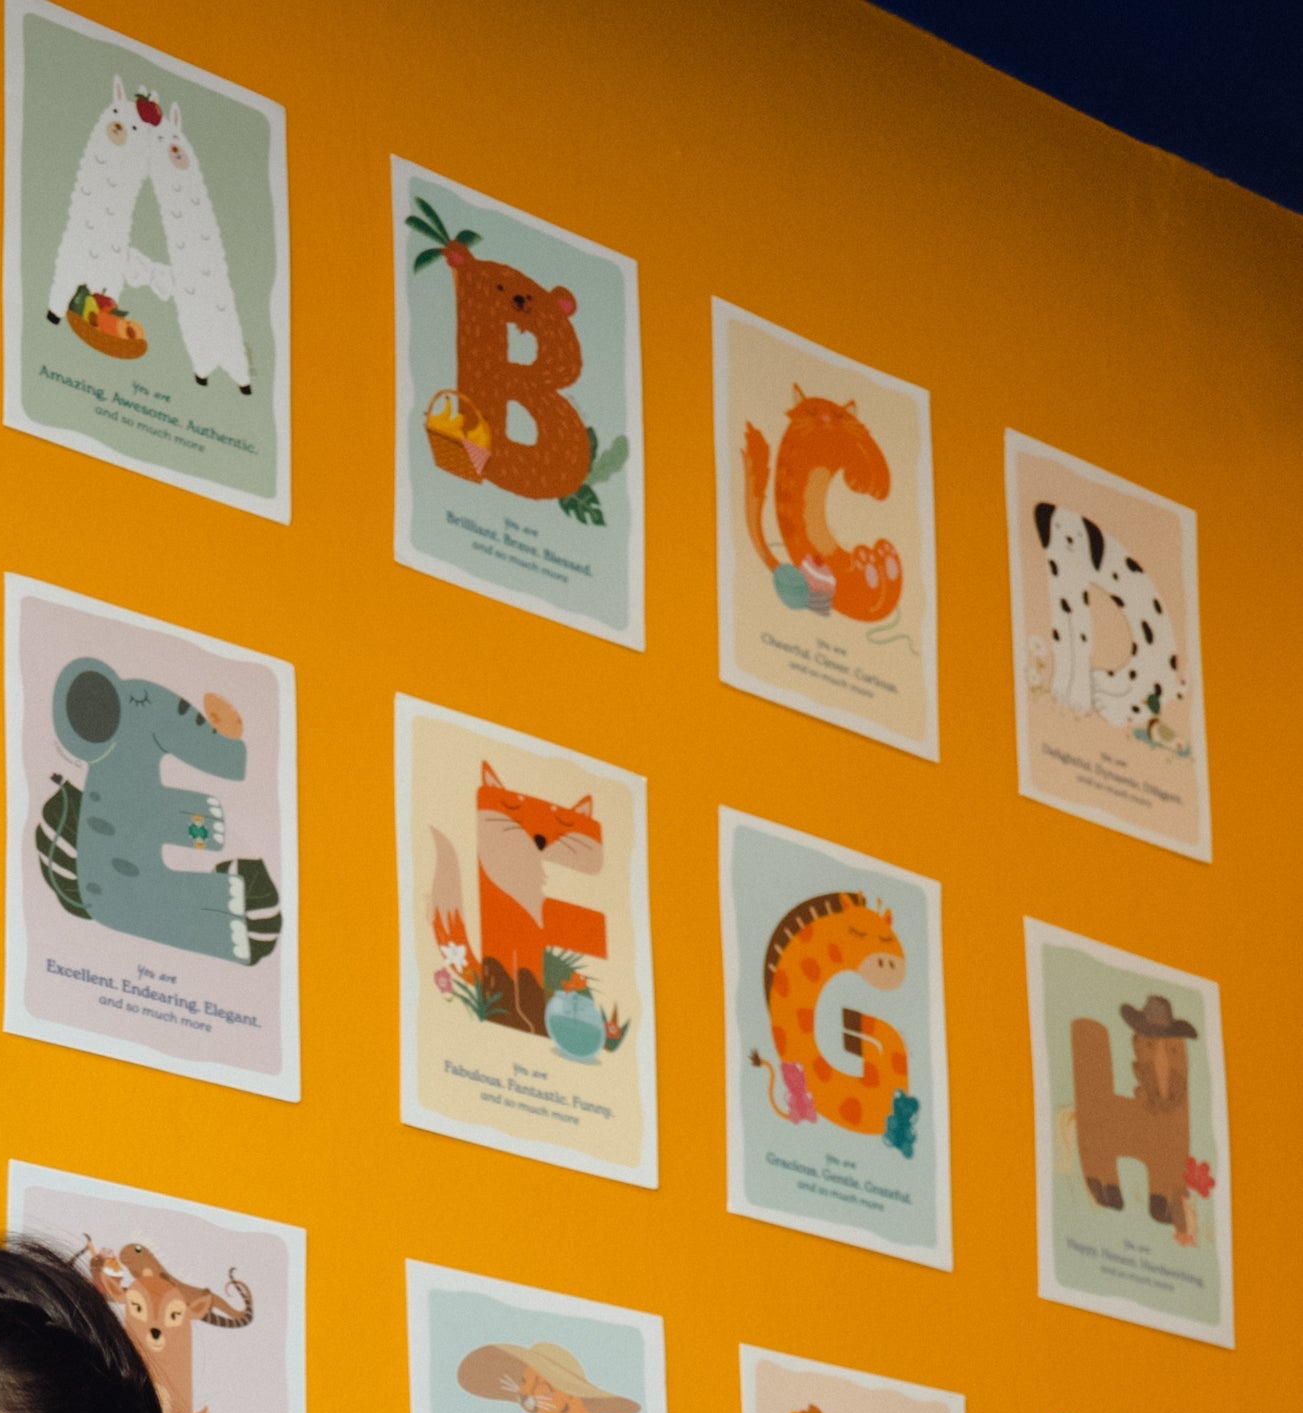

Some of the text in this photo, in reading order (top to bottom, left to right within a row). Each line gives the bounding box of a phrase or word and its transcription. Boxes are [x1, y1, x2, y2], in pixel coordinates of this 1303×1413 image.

[442, 240, 592, 500] B
[95, 406, 205, 452] and so much more
[52, 657, 251, 966] E
[476, 760, 609, 1038] F
[46, 958, 262, 1029] Excellent. Endearing. Elegant.
[98, 994, 212, 1032] and so much more
[159, 973, 177, 984] are
[764, 892, 909, 1135] G
[480, 1091, 579, 1125] and so much more
